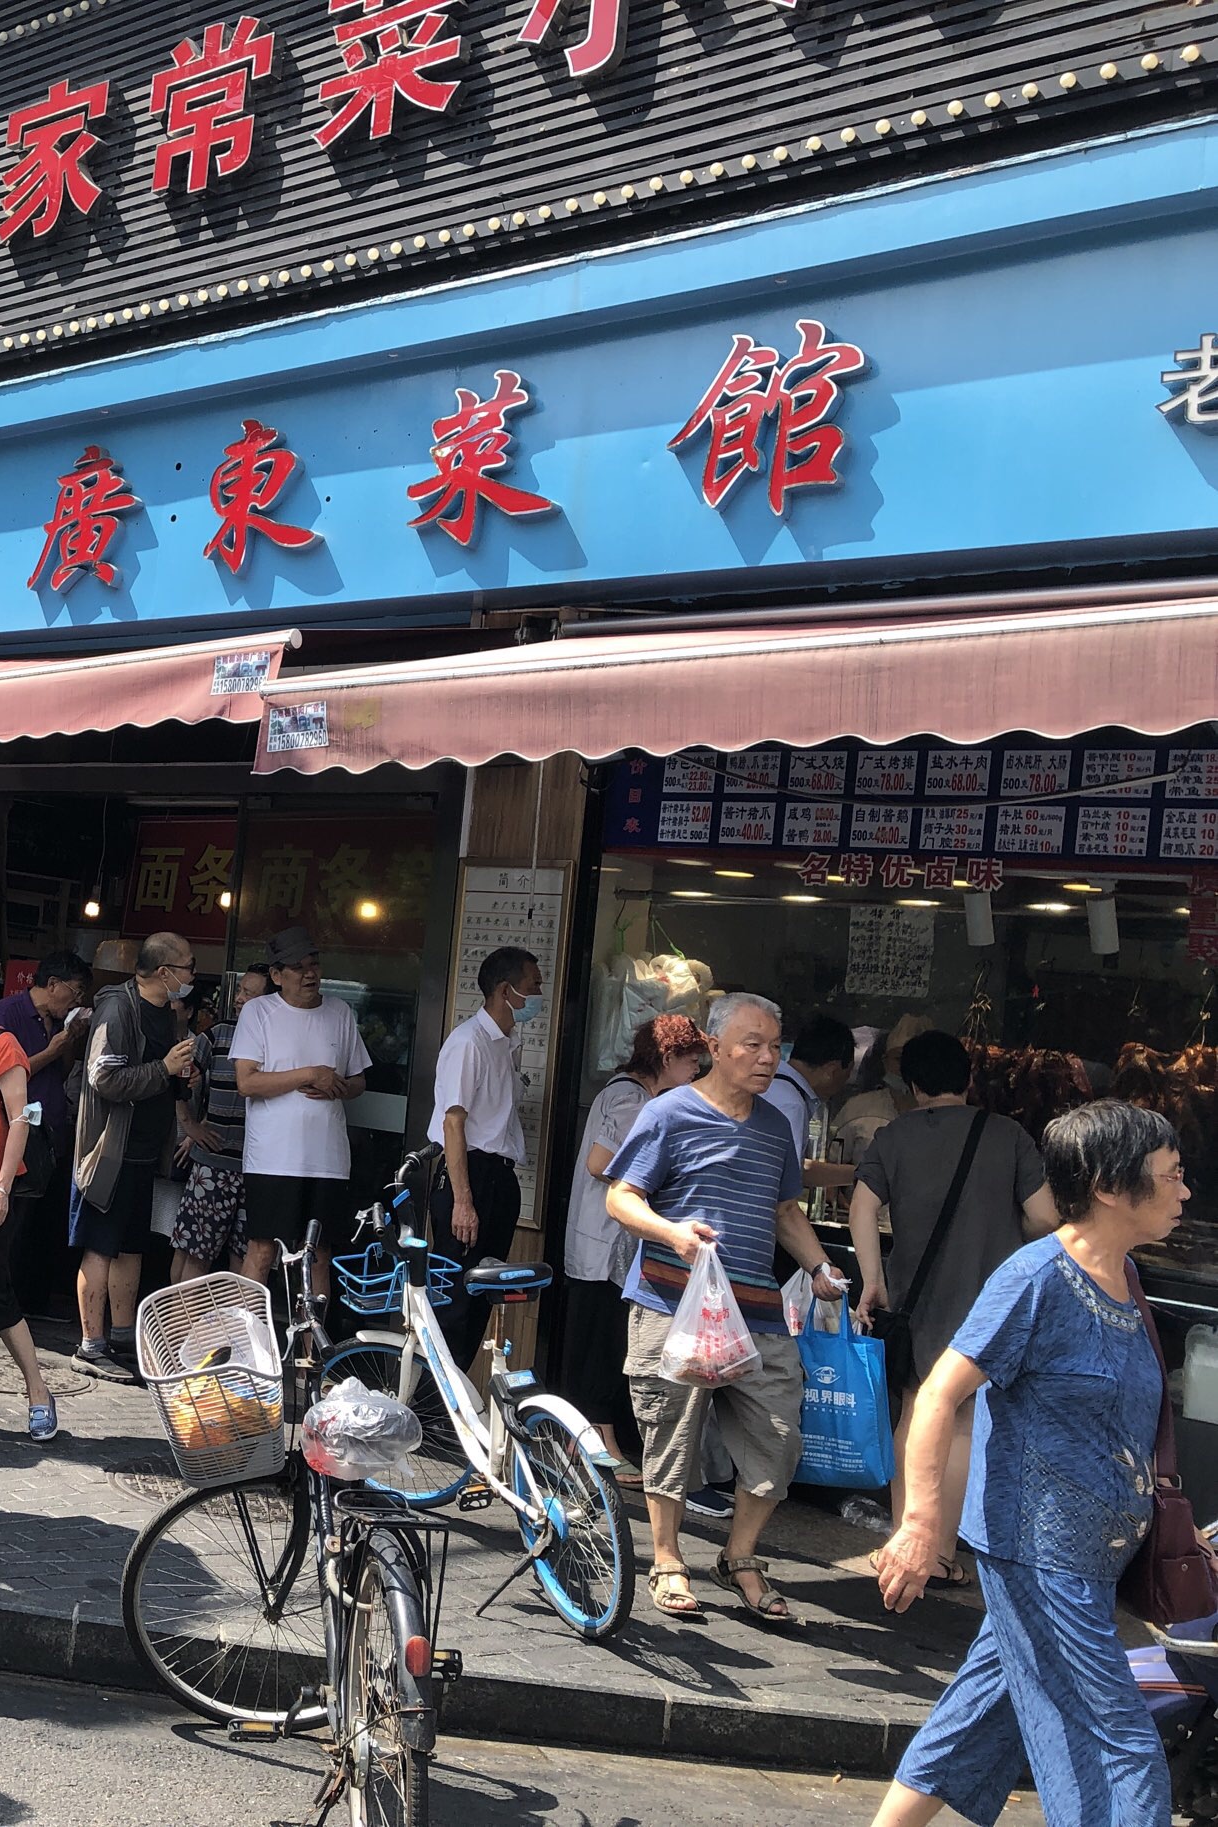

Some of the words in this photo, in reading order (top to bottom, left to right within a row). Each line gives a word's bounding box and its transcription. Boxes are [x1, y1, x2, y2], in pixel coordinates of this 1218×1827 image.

[931, 754, 988, 770] 盐水牛肉
[134, 843, 235, 914] 面条
[498, 872, 530, 889] 简介
[798, 851, 1004, 892] 名特优卤味
